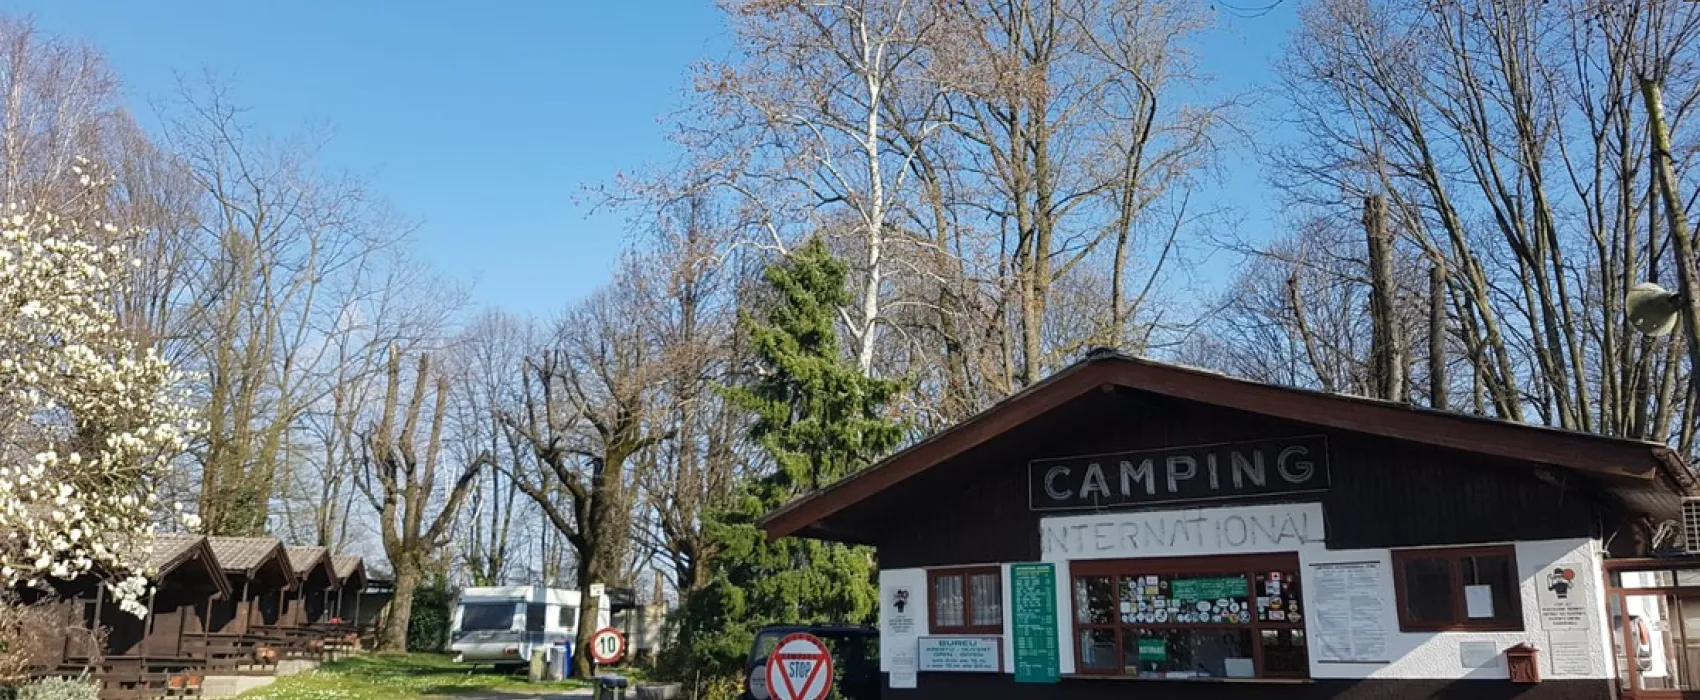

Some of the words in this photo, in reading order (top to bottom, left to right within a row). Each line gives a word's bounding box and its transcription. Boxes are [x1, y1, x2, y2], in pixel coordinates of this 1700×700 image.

[1044, 446, 1314, 499] CAMPING
[600, 635, 616, 654] 10
[789, 661, 812, 678] STOP
